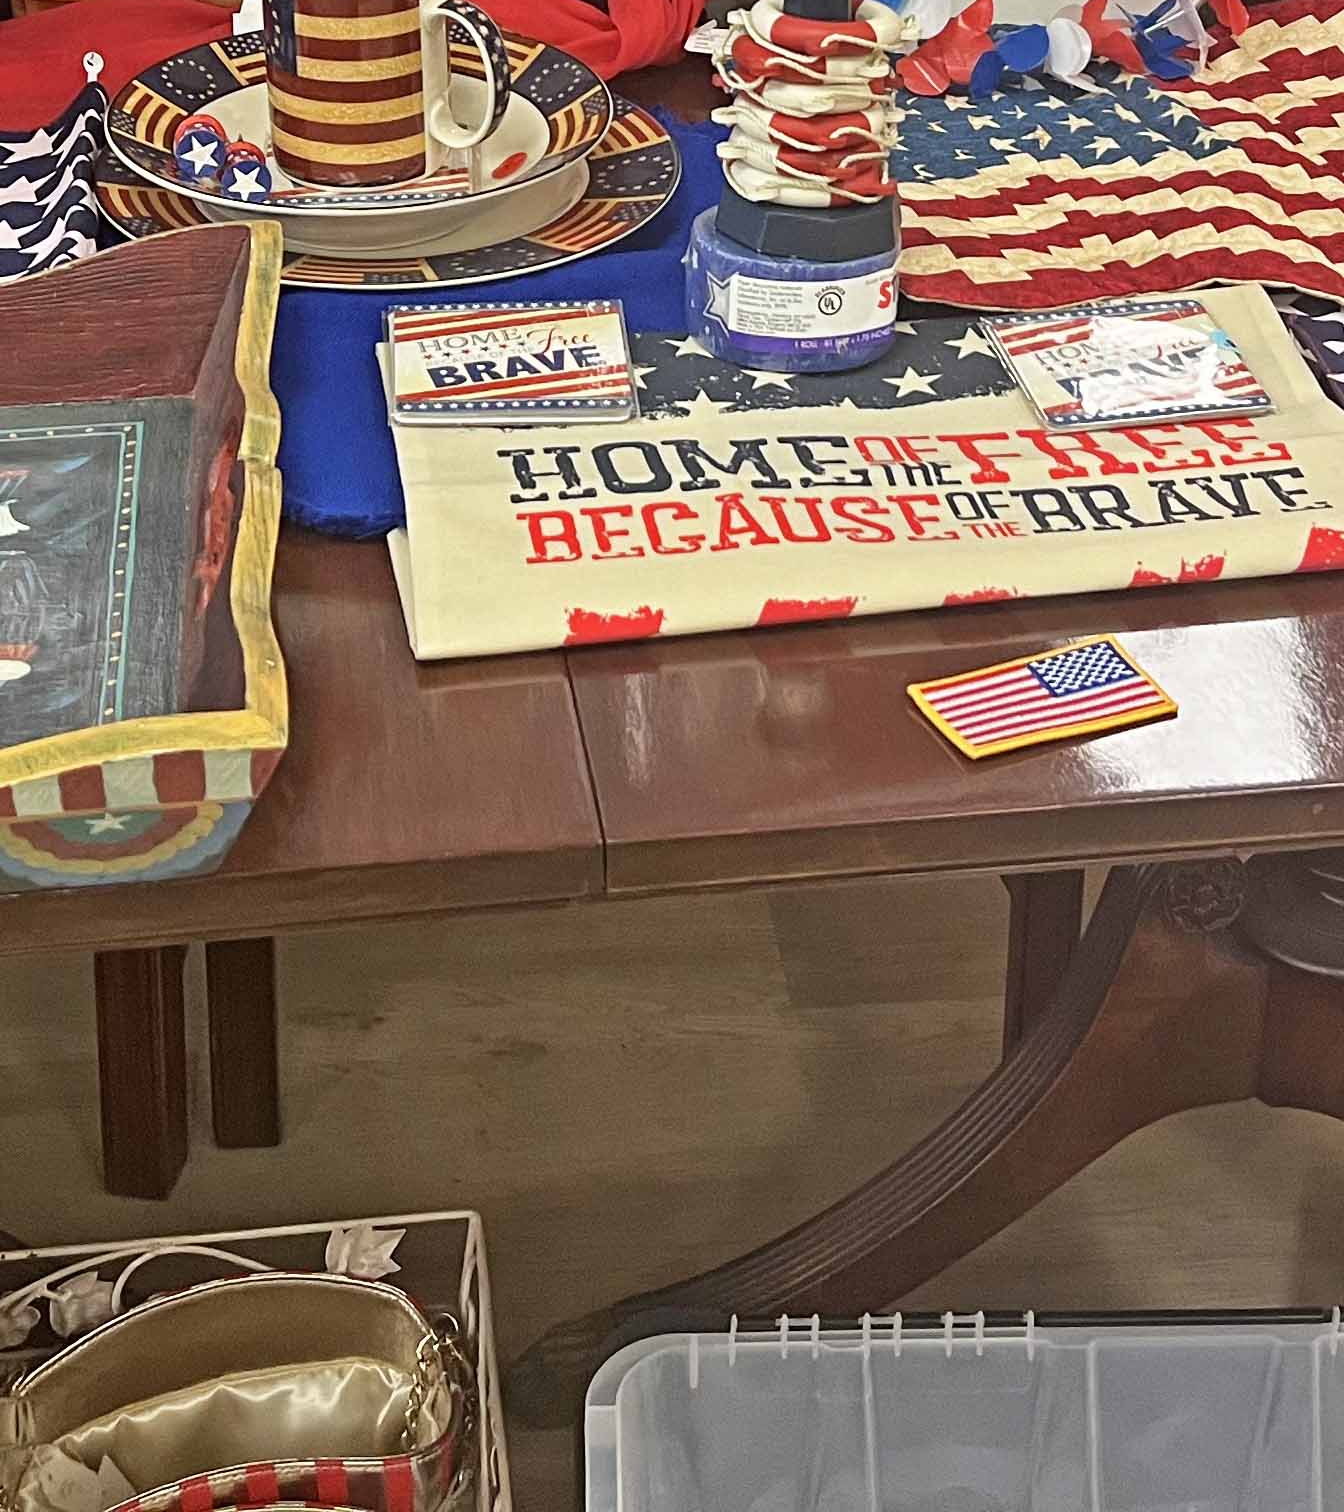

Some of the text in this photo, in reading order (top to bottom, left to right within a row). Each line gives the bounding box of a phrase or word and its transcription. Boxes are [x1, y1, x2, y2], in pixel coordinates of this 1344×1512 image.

[417, 323, 592, 354] HOME Free
[1034, 342, 1104, 366] HOM
[427, 344, 602, 389] BRAVE
[497, 418, 1292, 503] HOME OF THE FREE
[516, 467, 1333, 565] BECAUSE OF THE BRAVE
